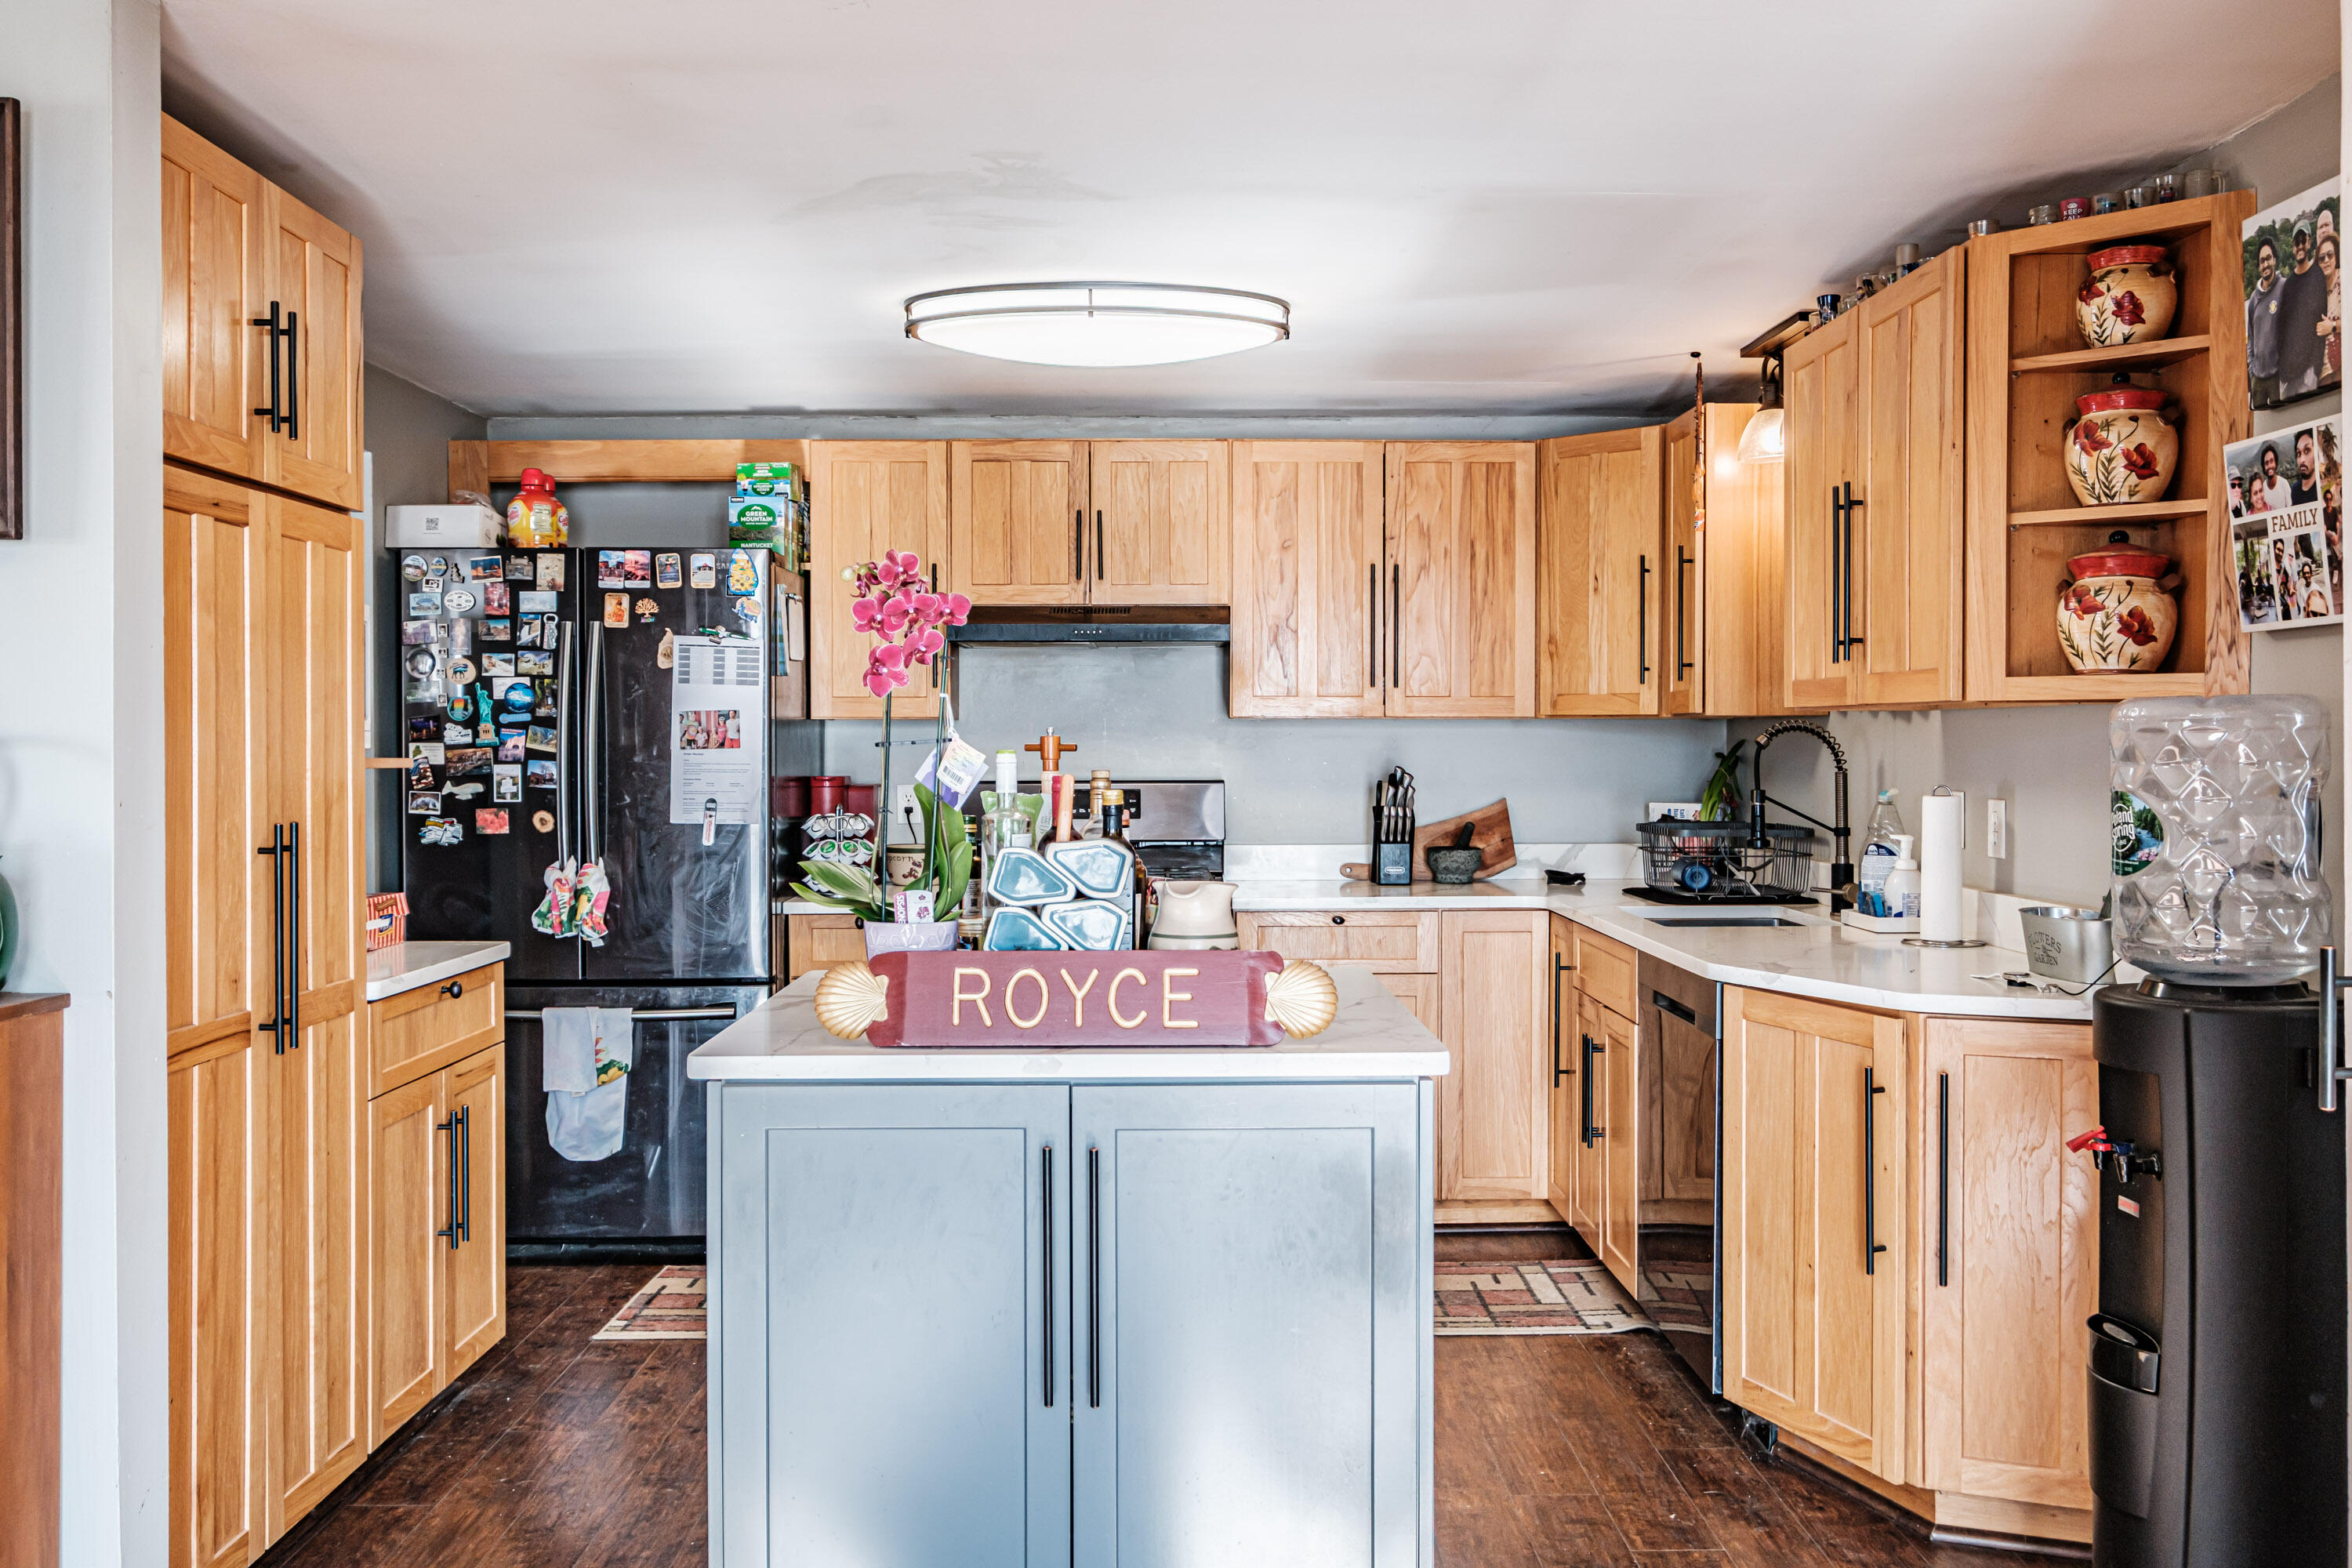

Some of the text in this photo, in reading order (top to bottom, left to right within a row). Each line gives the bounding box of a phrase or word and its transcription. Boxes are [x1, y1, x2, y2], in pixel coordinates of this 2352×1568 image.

[2271, 508, 2318, 533] FAMILY
[896, 895, 906, 924] ENOPSIS
[2028, 931, 2062, 954] FLOWERS
[952, 967, 1200, 1029] ROYCE
